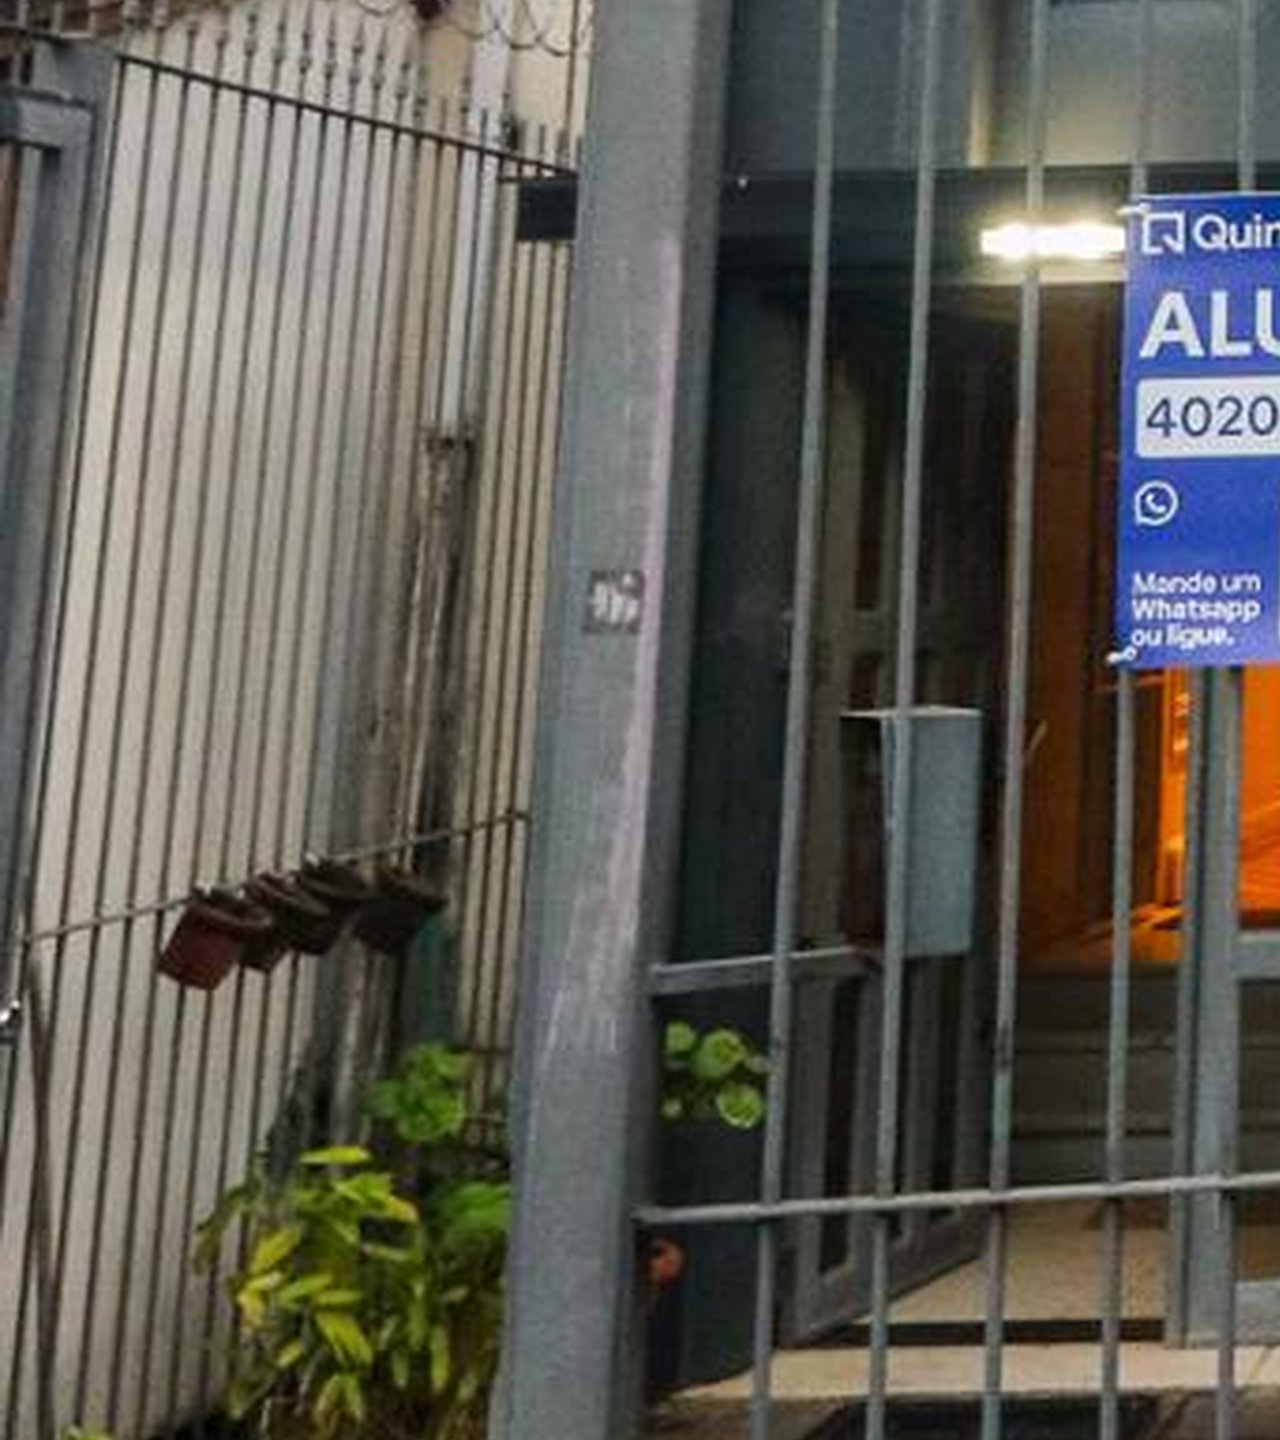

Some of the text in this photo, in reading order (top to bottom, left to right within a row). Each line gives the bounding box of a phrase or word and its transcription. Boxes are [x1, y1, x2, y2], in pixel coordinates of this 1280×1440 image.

[1132, 571, 1261, 595] Mande um
[1132, 598, 1261, 623] Whatsapp
[1131, 623, 1236, 650] ou ligue.
